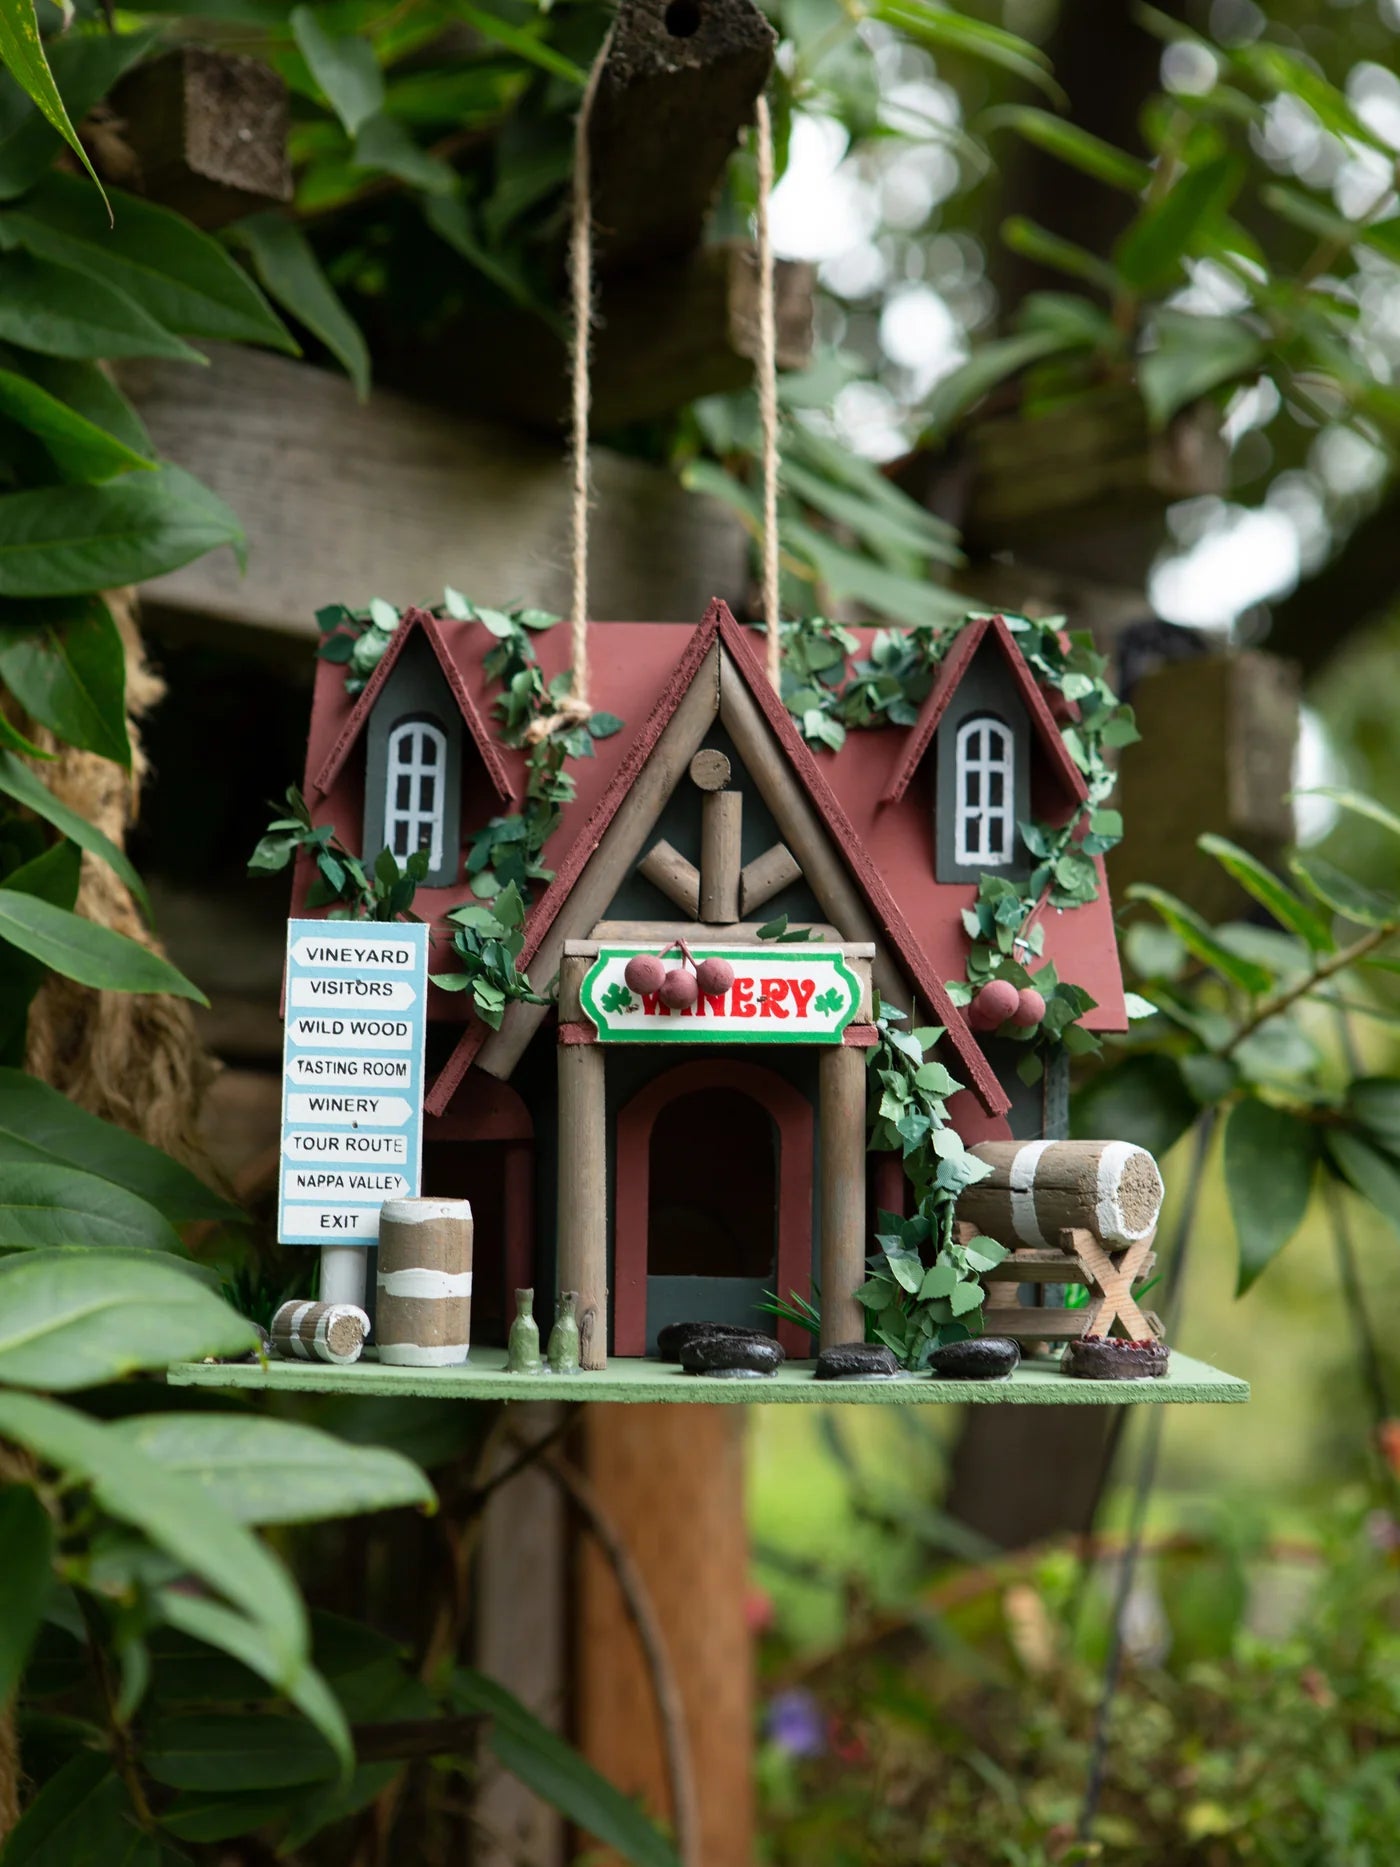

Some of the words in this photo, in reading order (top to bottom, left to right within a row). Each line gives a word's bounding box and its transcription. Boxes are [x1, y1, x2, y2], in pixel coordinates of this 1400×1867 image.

[306, 947, 409, 964] VINEYARD
[310, 980, 393, 996] VISITORS
[641, 977, 817, 1019] NERY
[299, 1020, 344, 1035] WILD
[351, 1021, 408, 1036] WOOD
[297, 1059, 358, 1075] TASTING
[363, 1061, 407, 1076] ROOM
[309, 1097, 379, 1112] WINERY
[294, 1136, 339, 1151] TOUR
[345, 1137, 403, 1153] ROUTE
[297, 1174, 344, 1188] NAPPA
[349, 1175, 402, 1190] VALLEY
[320, 1214, 359, 1228] EXIT
